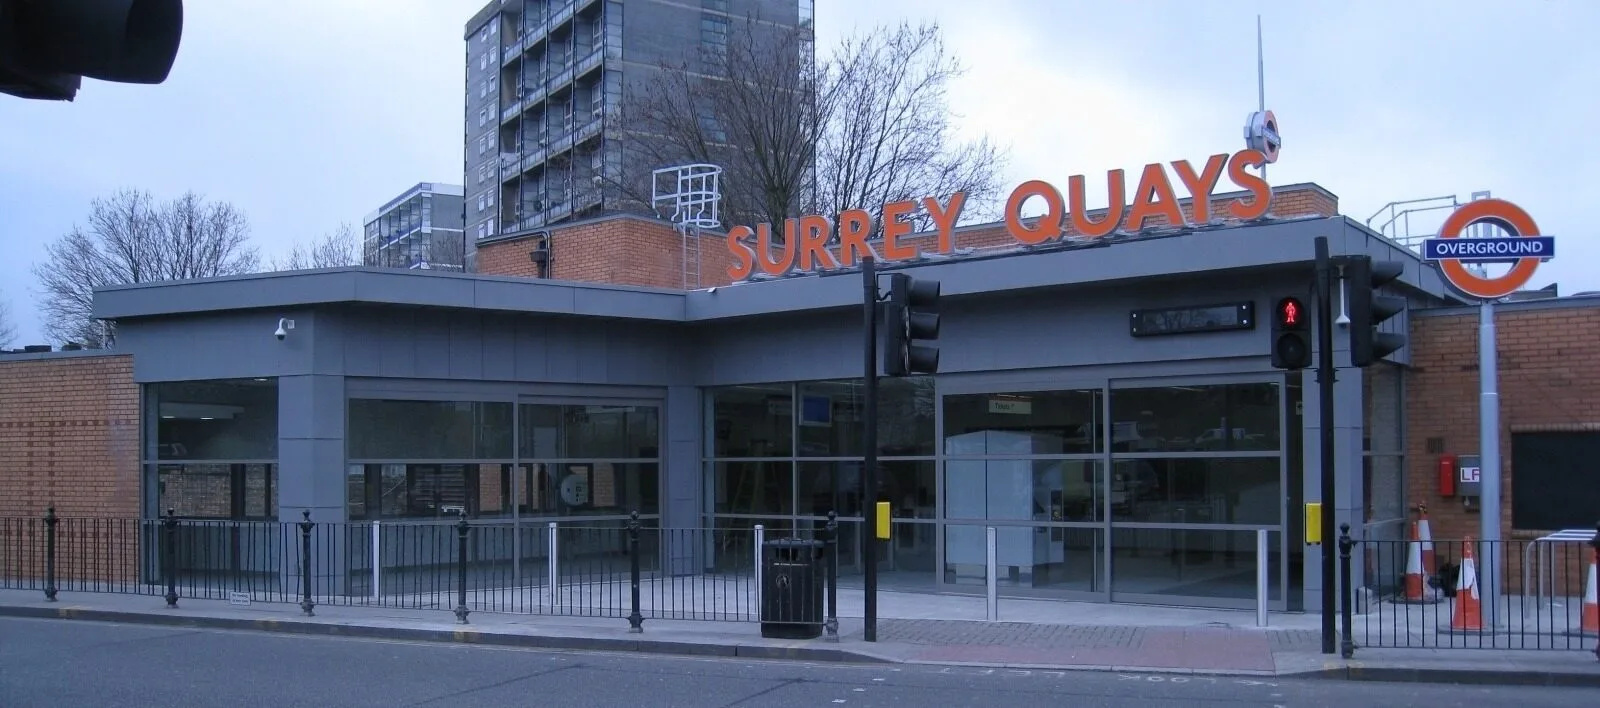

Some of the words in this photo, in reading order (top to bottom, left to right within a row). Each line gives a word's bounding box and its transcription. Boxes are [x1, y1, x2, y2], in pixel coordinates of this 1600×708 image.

[726, 191, 968, 281] SURREY
[1004, 149, 1273, 245] QUAYS
[1436, 241, 1543, 255] OVERGROUND
